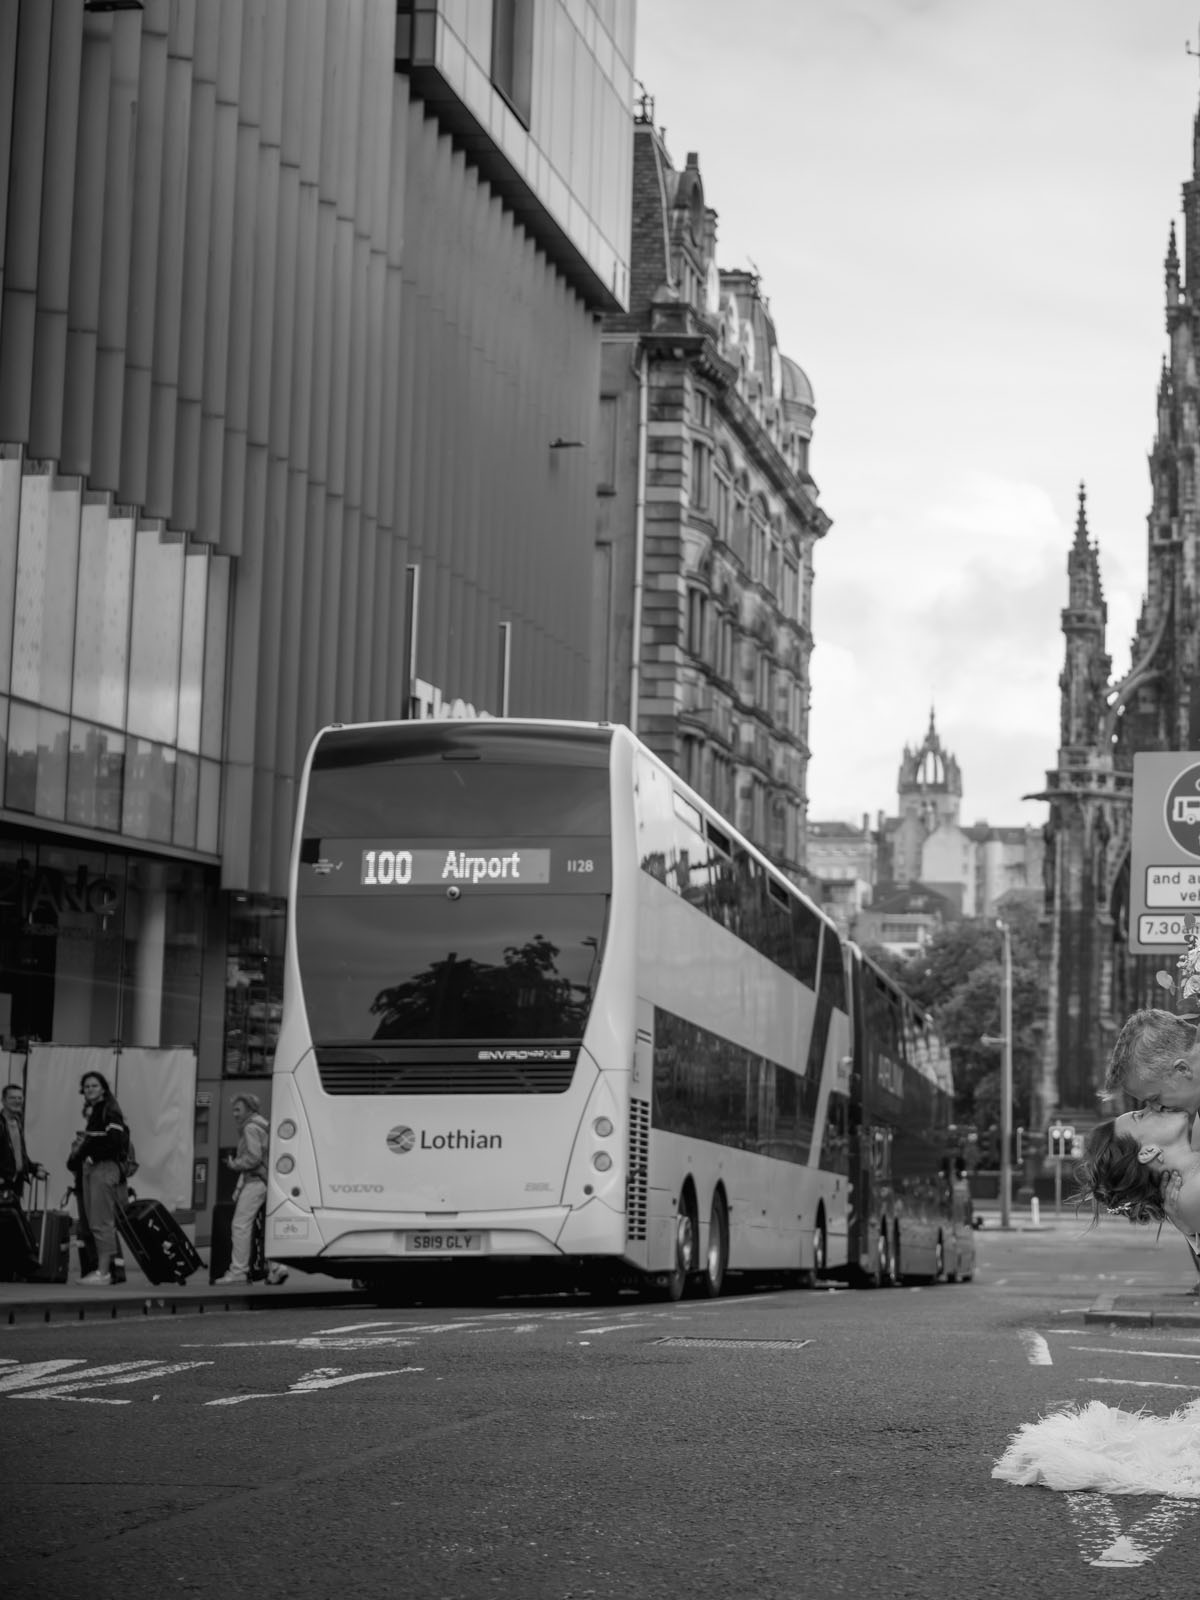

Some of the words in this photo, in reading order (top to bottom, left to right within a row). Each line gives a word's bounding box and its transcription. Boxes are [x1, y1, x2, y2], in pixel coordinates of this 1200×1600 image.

[364, 850, 413, 885] 100
[441, 850, 521, 884] Airport
[567, 859, 594, 873] 1128
[1152, 872, 1181, 884] and
[420, 1129, 503, 1150] Lothian
[328, 1183, 385, 1193] VOLVO
[414, 1235, 443, 1249] SB19
[446, 1235, 473, 1249] GLY
